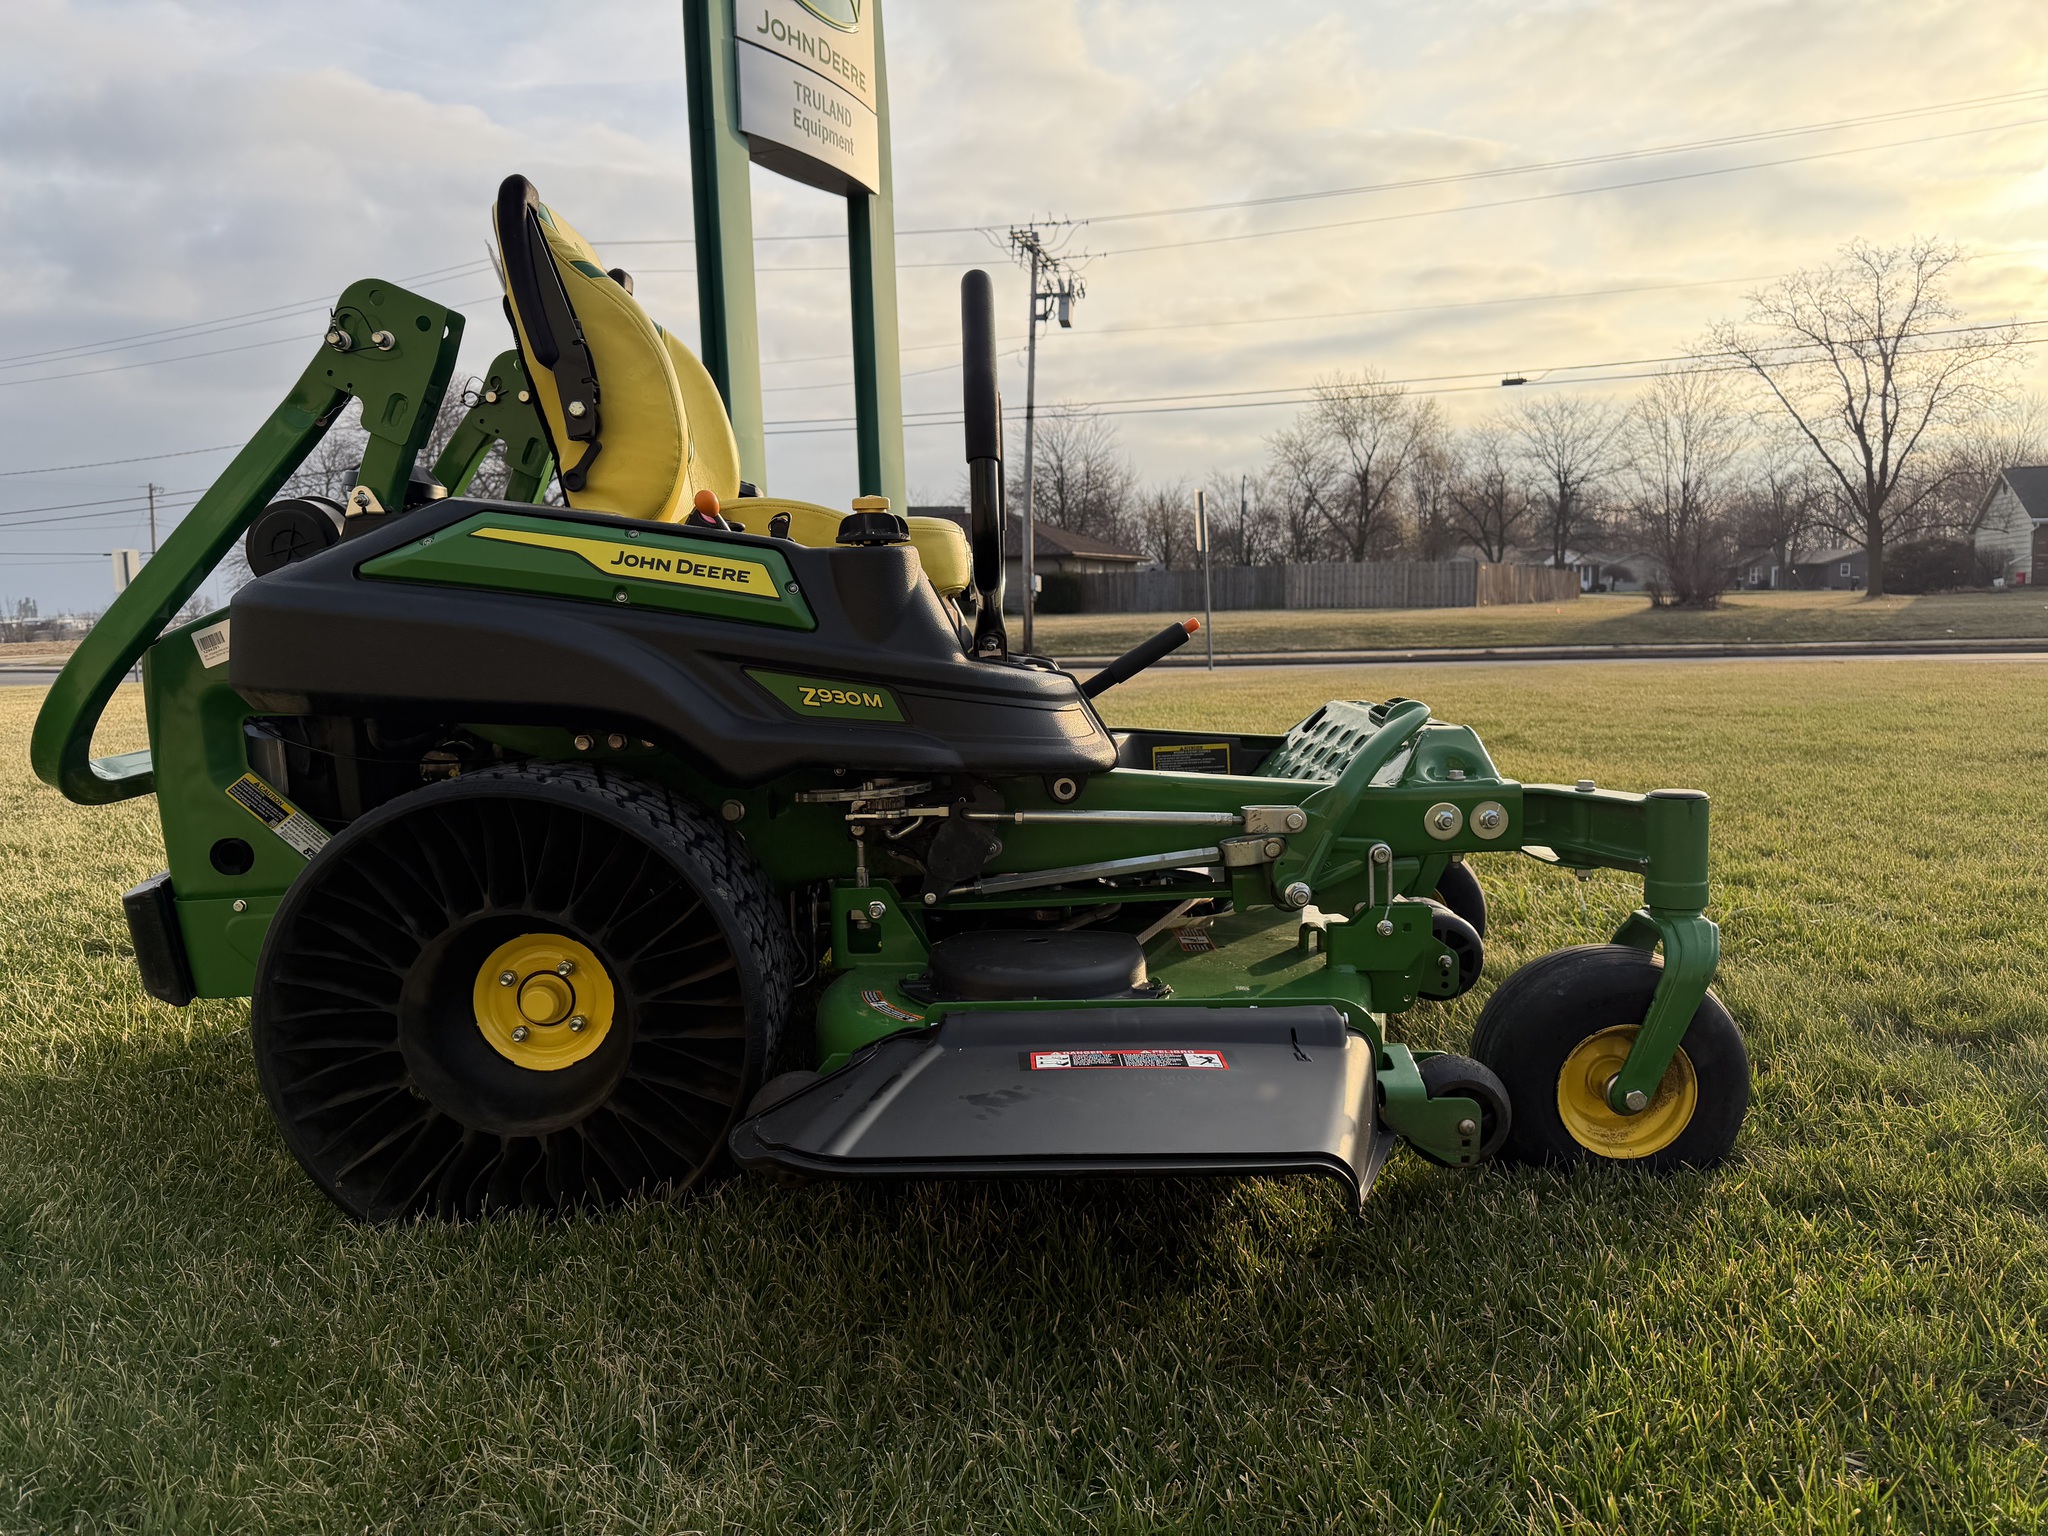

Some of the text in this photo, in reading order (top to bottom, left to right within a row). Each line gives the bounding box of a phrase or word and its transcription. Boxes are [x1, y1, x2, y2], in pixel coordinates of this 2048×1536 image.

[757, 9, 867, 93] JOHN DEERE
[793, 80, 852, 128] TRULAND
[793, 107, 854, 156] Equipment
[610, 551, 751, 583] JOHN DEERE
[798, 686, 884, 708] Z930M
[259, 785, 284, 806] CAUTION
